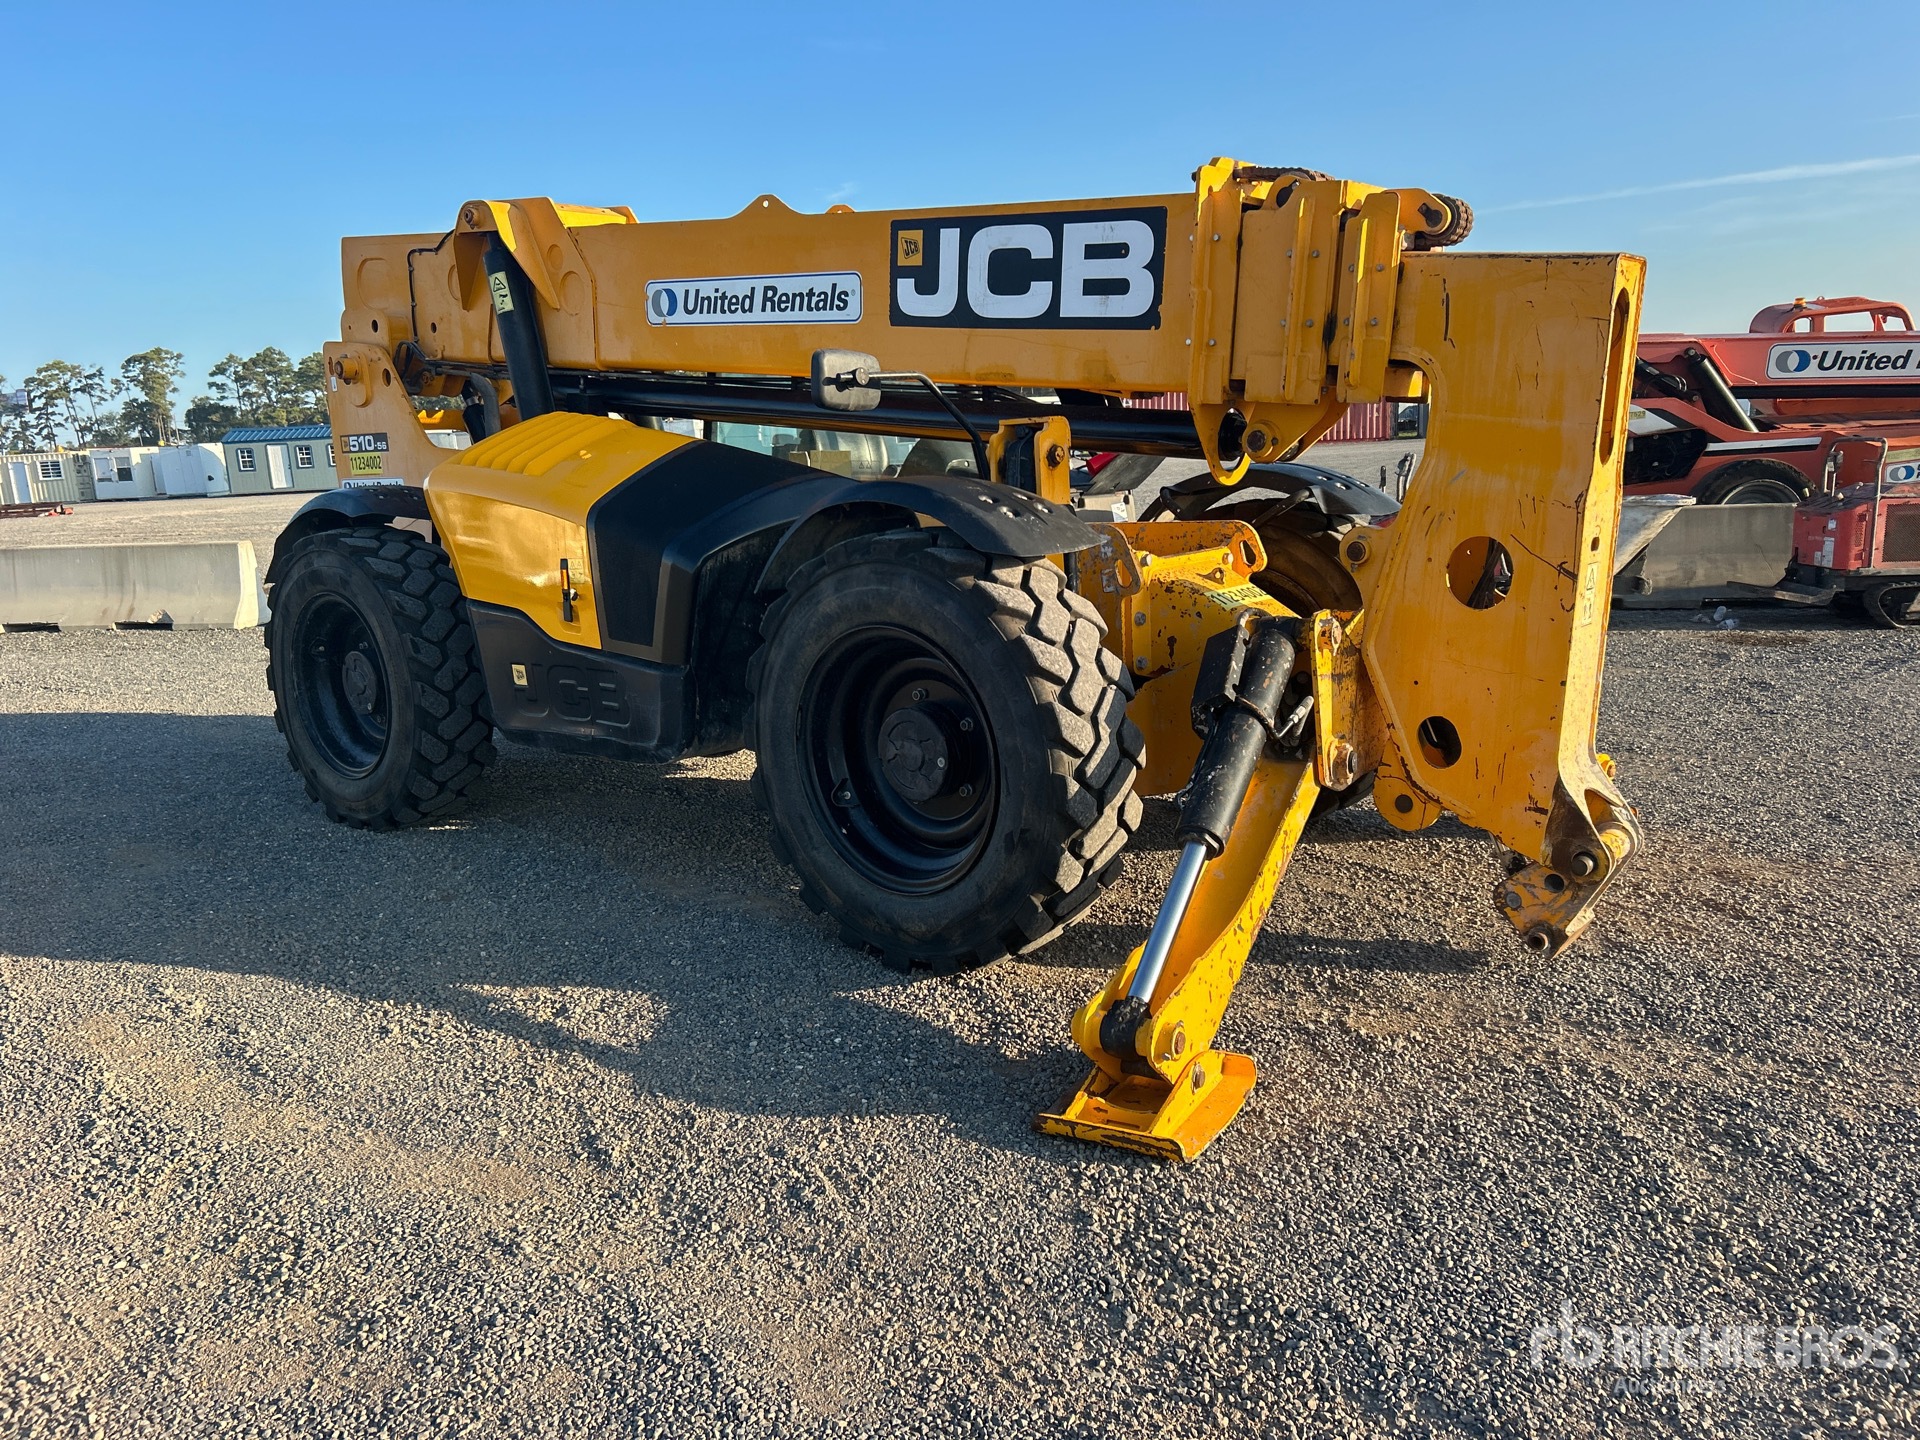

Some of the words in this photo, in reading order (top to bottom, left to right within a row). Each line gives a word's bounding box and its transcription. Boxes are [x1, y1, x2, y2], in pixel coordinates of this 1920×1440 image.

[904, 239, 919, 257] JCB
[896, 220, 1155, 318] JCB
[683, 288, 756, 315] United
[761, 283, 849, 312] Rentals
[1817, 349, 1914, 371] United
[350, 455, 382, 471] 11234002
[514, 663, 632, 728] JCB
